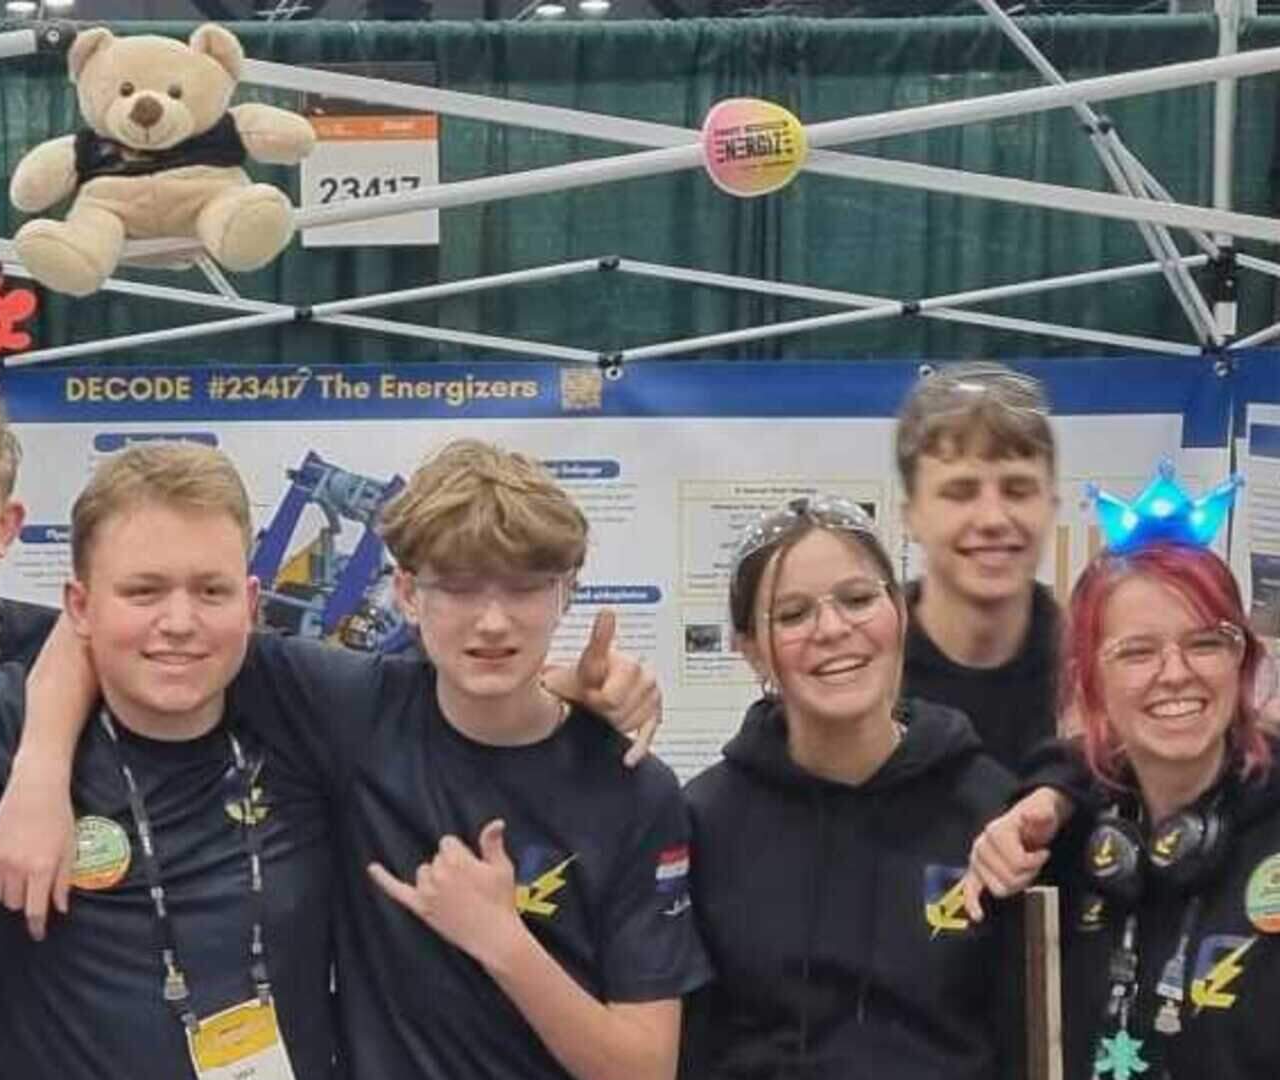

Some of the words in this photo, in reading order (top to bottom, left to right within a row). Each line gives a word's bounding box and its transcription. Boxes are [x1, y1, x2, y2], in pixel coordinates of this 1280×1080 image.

[66, 376, 192, 401] DECODE
[207, 374, 308, 401] #23417
[320, 375, 370, 400] The
[381, 373, 538, 406] Energizers
